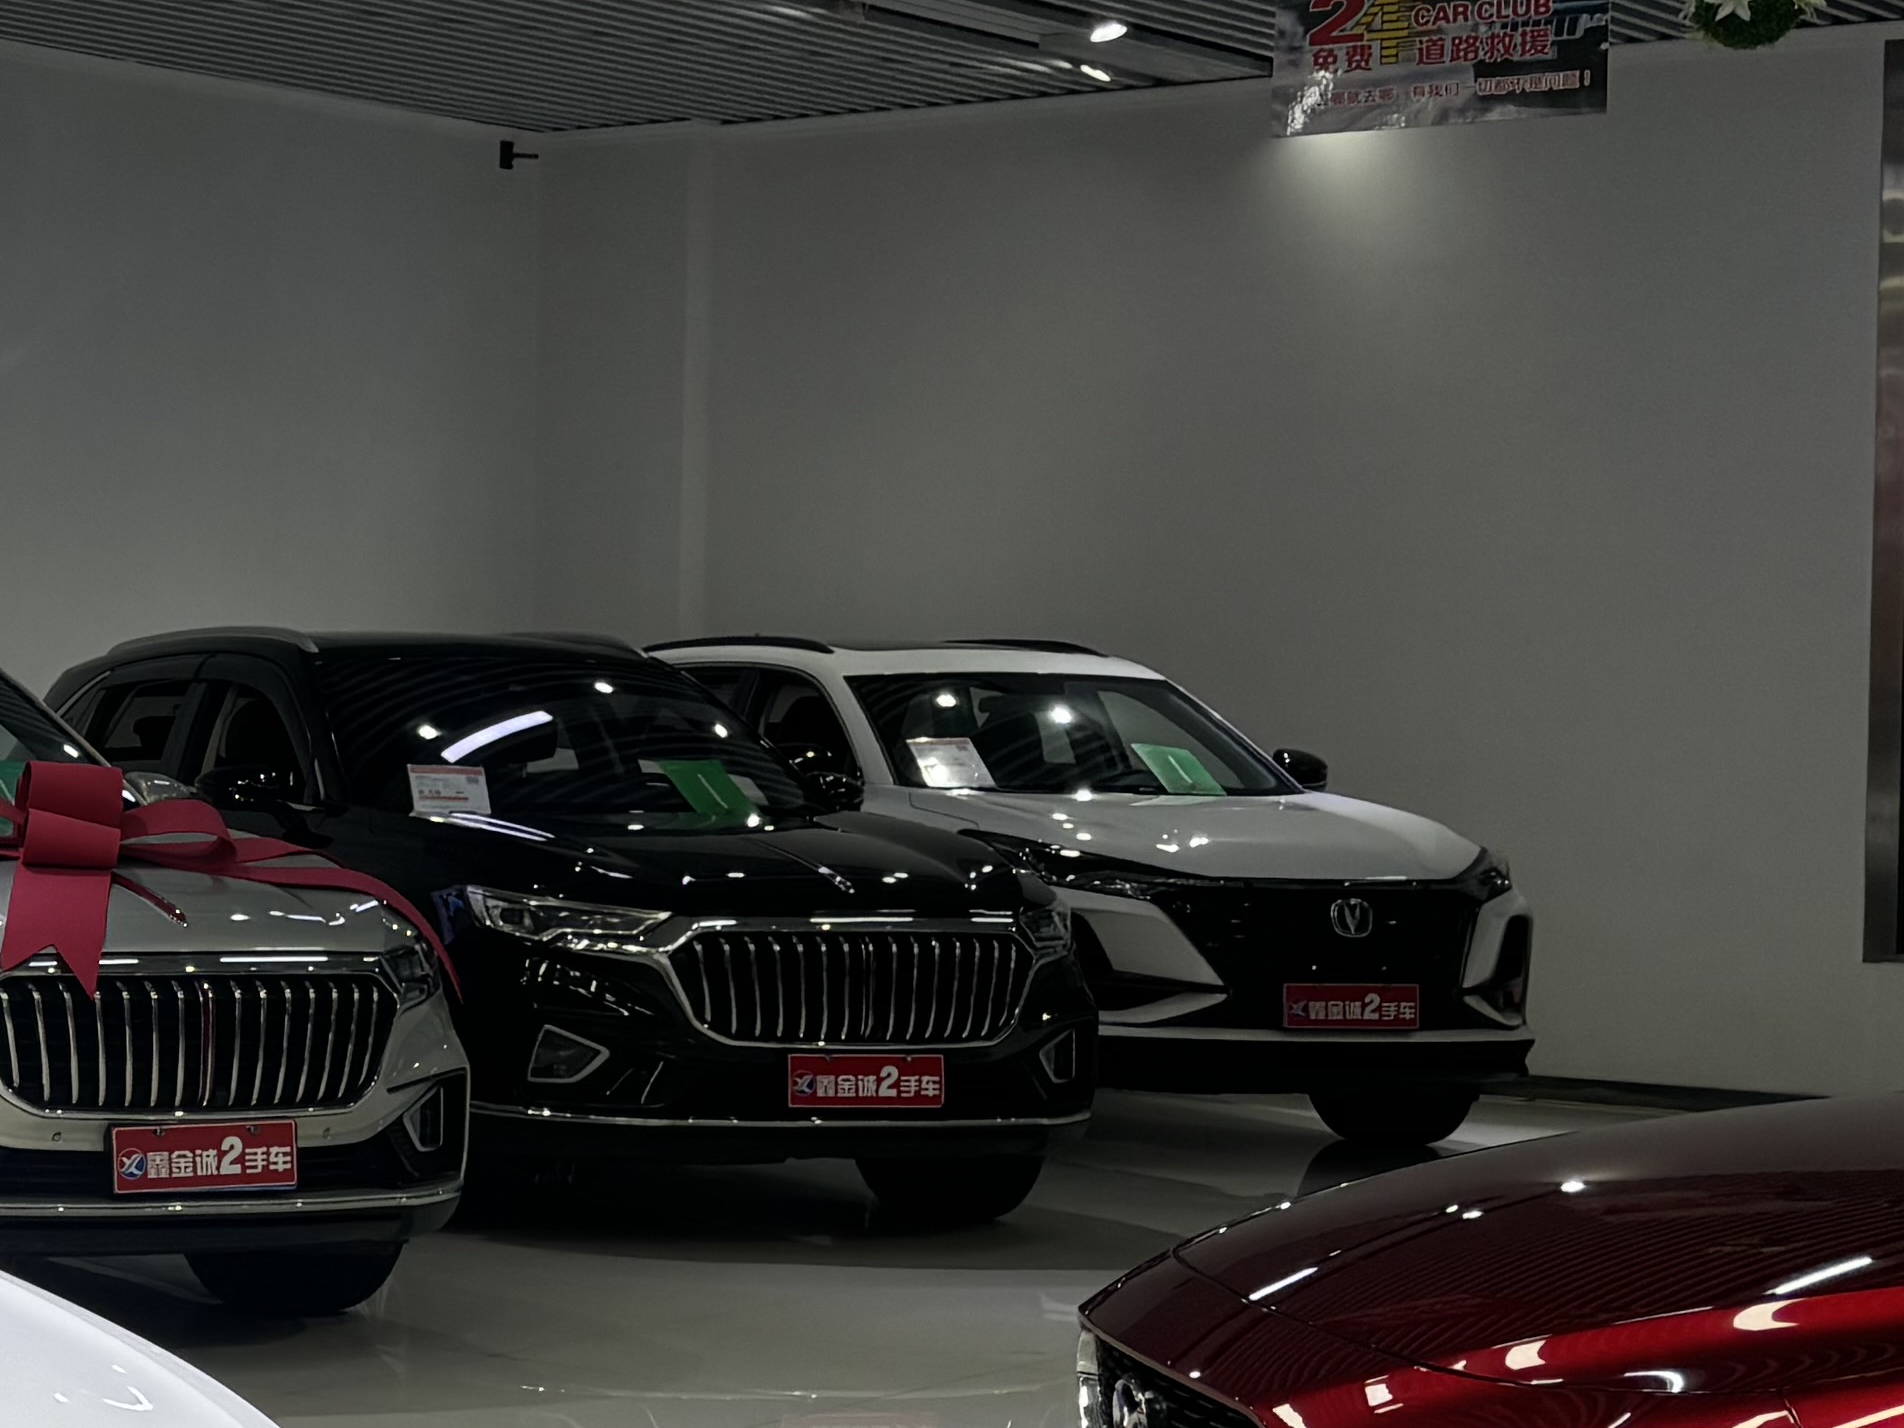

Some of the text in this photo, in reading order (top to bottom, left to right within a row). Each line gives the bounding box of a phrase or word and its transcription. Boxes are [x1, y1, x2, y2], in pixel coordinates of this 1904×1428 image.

[1411, 1, 1471, 28] CAR
[1312, 27, 1552, 72] 免费 道路救援
[816, 1066, 940, 1097] 鑫金诚2手车
[147, 1136, 291, 1178] 鑫金诚2手车
